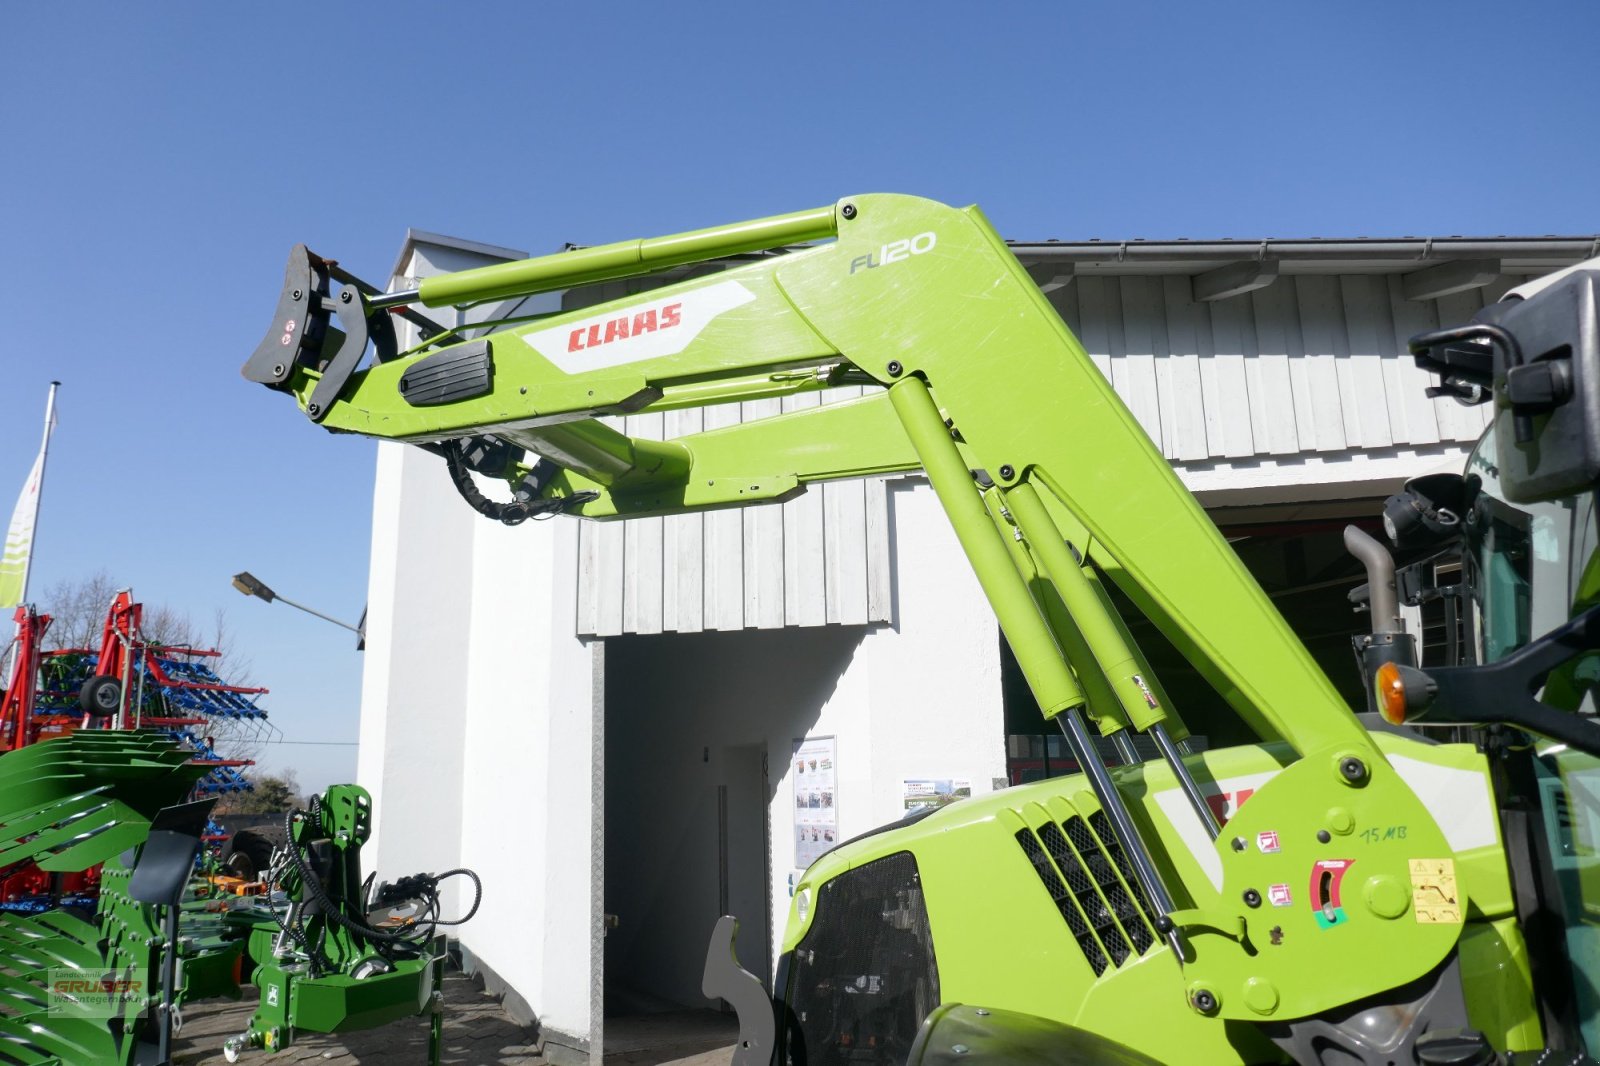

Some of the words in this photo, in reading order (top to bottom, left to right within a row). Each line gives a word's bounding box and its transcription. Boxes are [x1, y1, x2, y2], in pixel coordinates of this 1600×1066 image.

[567, 302, 682, 353] CLAAS
[1359, 827, 1379, 844] 15
[1383, 826, 1407, 841] MB
